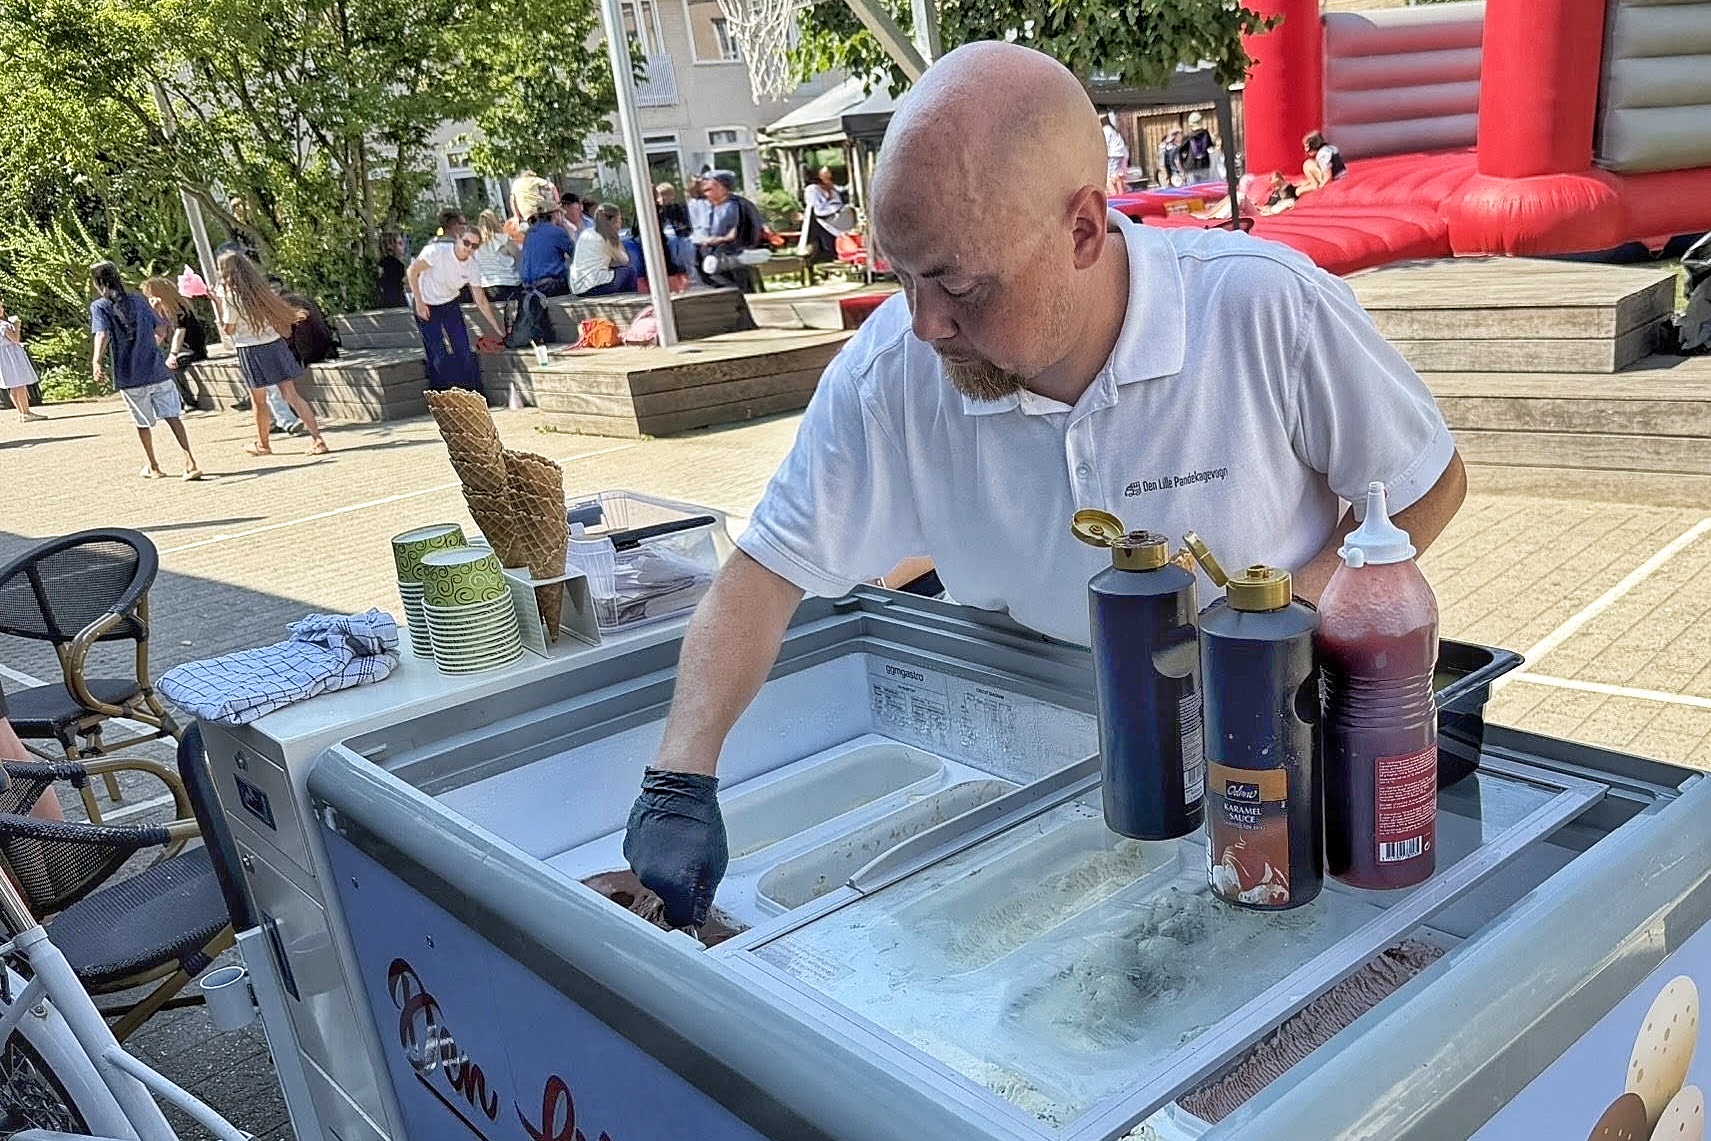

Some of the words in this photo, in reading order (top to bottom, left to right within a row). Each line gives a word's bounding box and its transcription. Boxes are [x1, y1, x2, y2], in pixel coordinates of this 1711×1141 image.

[1142, 481, 1158, 492] Den
[1159, 476, 1173, 490] Lille
[1174, 467, 1228, 487] Pandekagevogn
[885, 664, 924, 682] ggmgastro
[1223, 802, 1262, 816] KARAMEL
[1230, 813, 1256, 823] SAUCE
